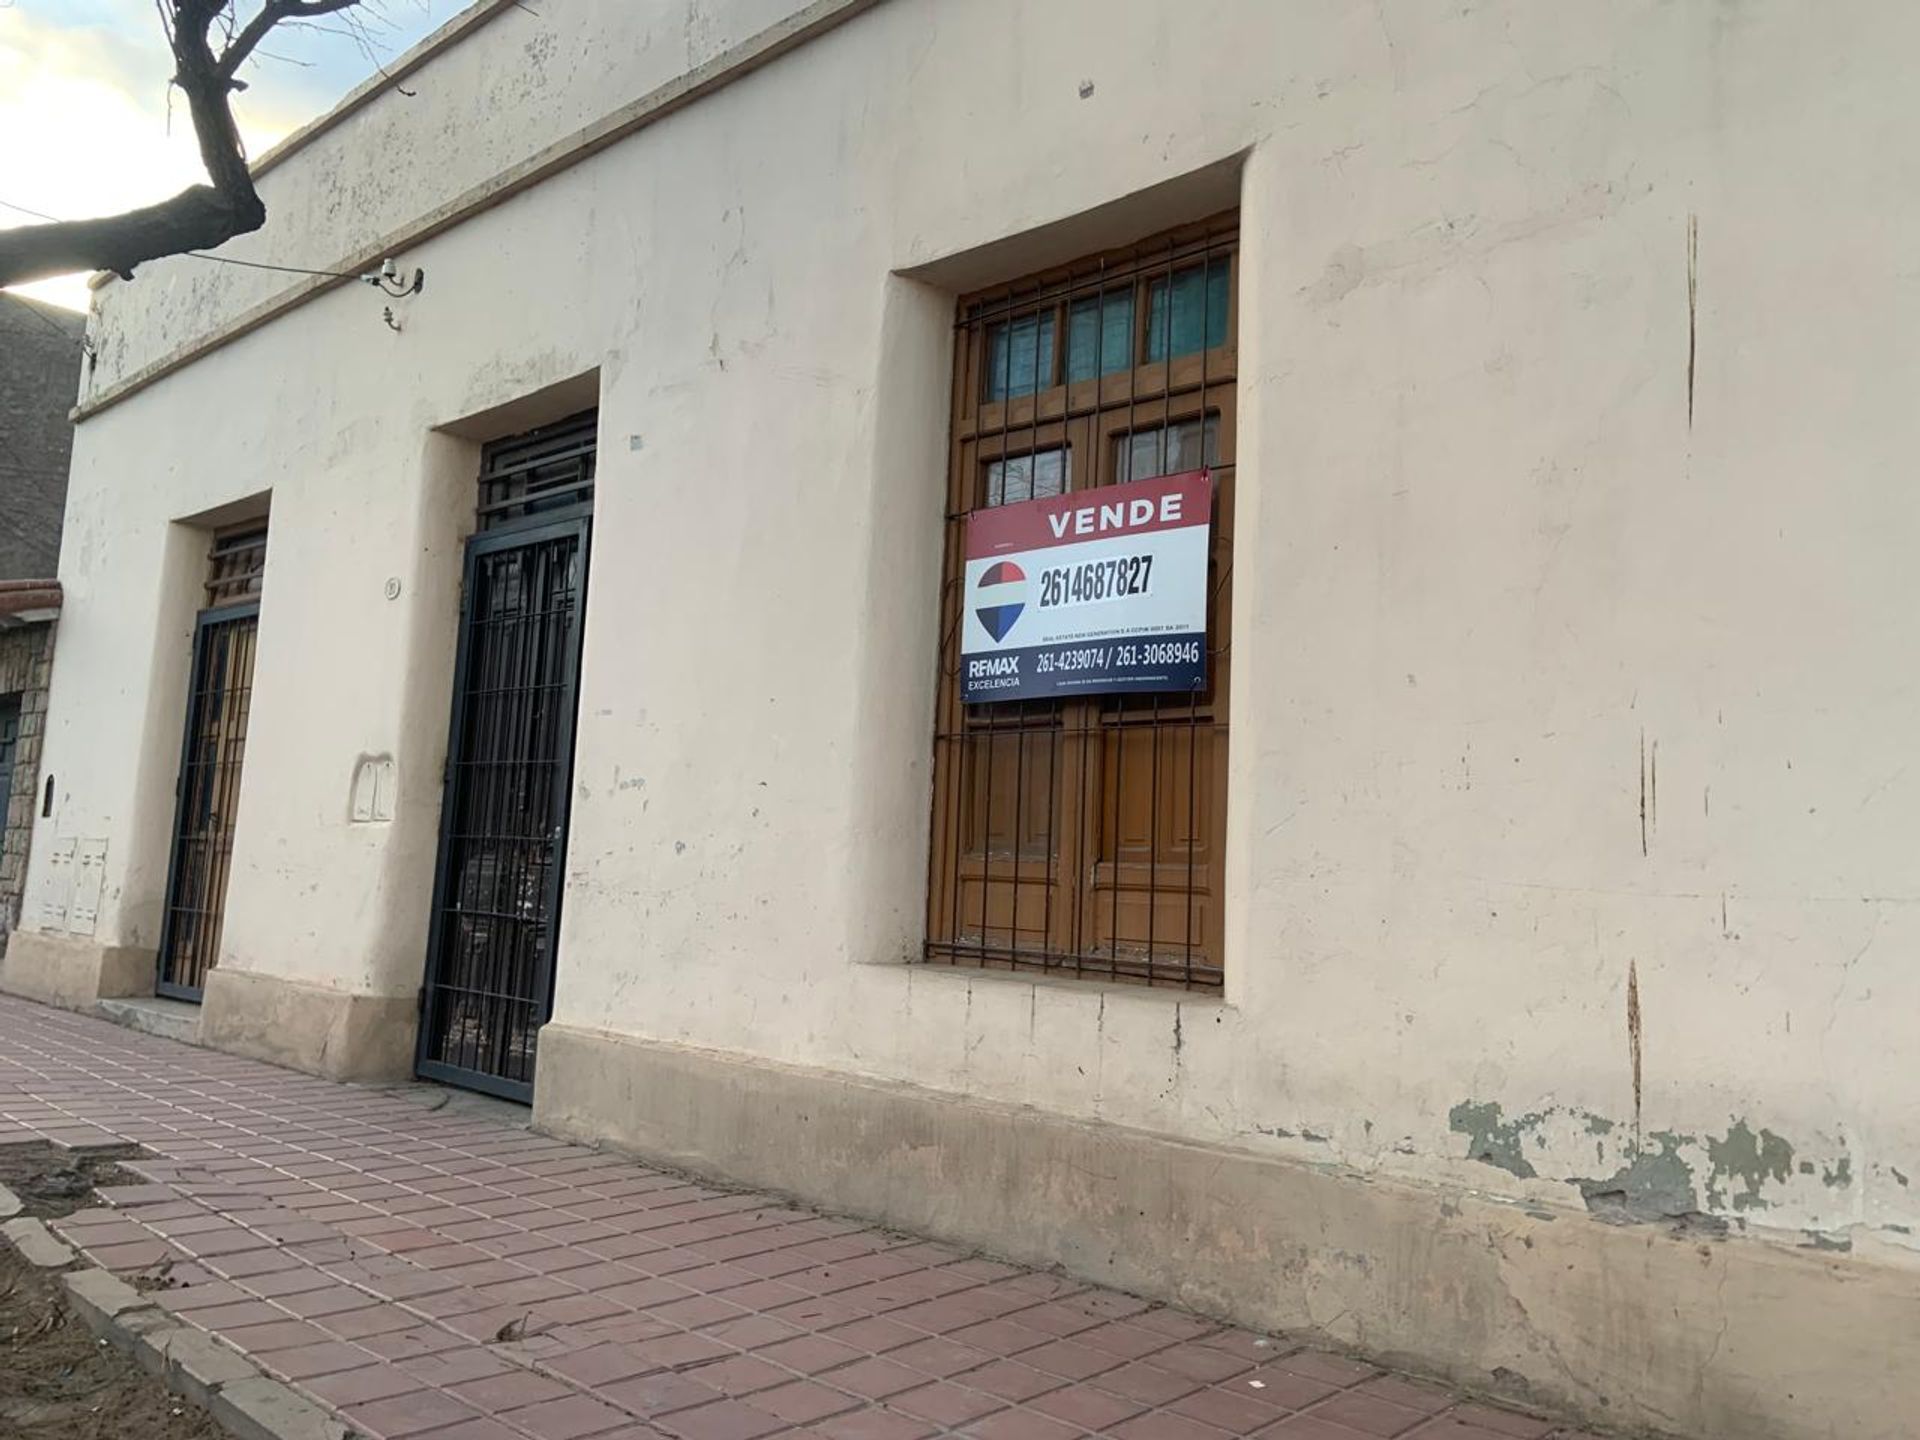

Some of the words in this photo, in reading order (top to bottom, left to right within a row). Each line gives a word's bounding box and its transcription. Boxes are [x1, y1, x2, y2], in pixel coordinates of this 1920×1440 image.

[1048, 493, 1183, 539] VENDE
[1039, 554, 1153, 608] 2614687827
[1036, 648, 1104, 673] 261-4239074
[1104, 647, 1113, 670] /
[1115, 641, 1200, 667] 261-3068946
[968, 676, 1020, 691] EXCELENCIA
